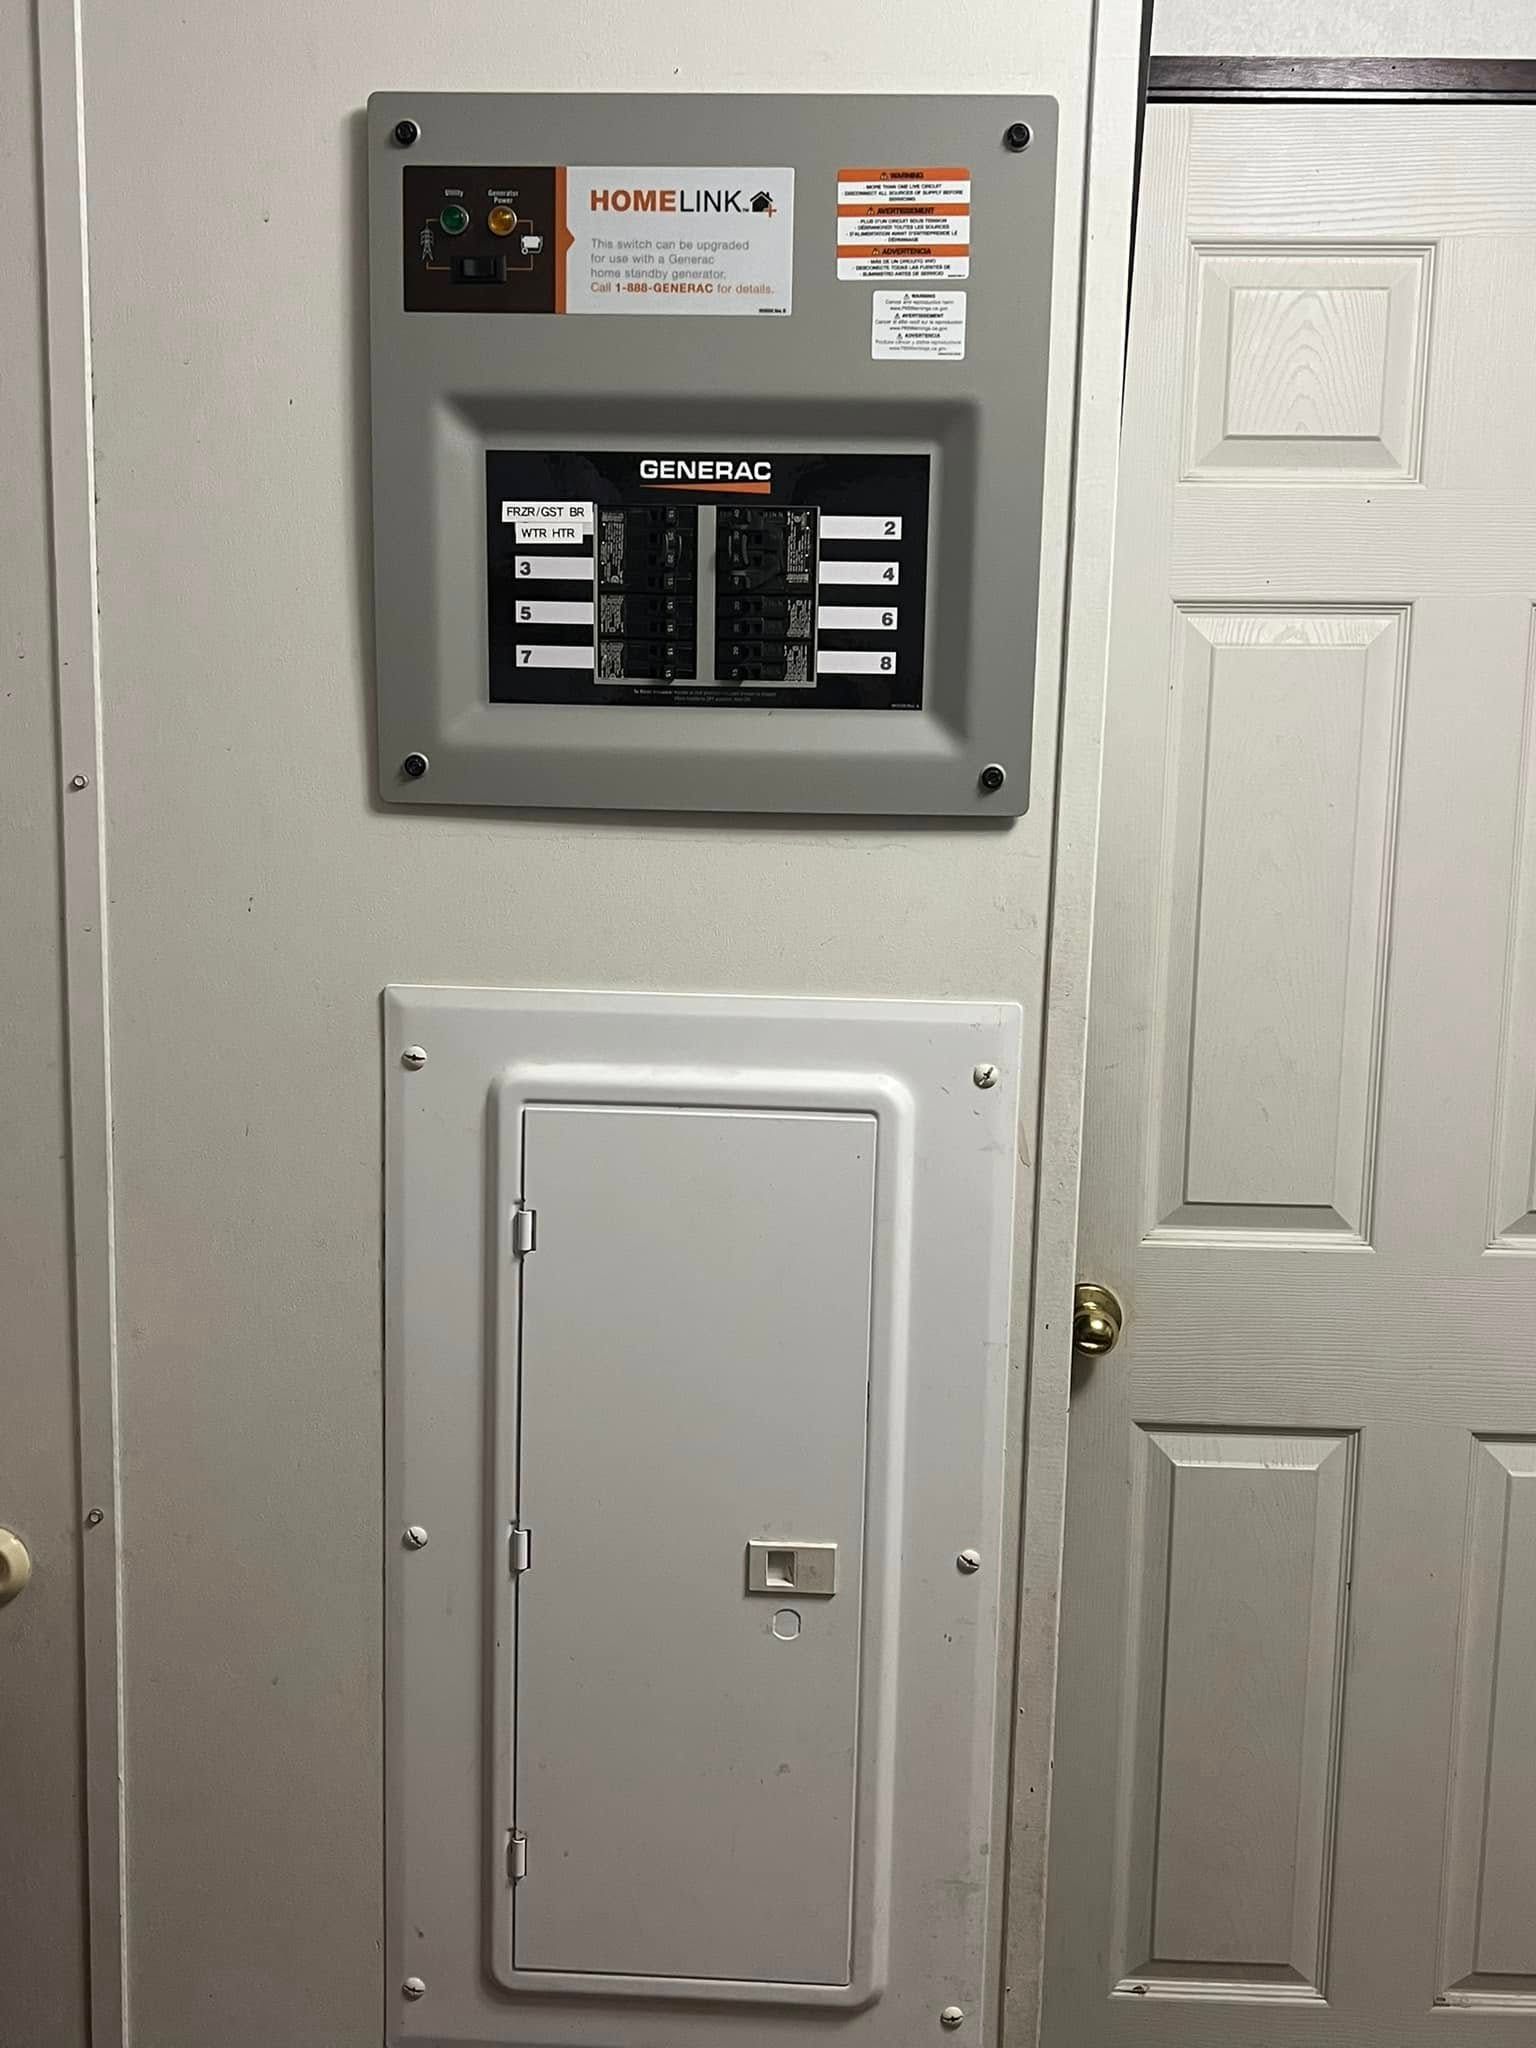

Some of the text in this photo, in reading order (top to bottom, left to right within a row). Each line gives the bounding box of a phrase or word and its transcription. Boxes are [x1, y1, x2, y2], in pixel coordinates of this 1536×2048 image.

[444, 189, 464, 198] Utility
[487, 189, 519, 197] Generator
[591, 238, 750, 253] This switch can be upgraded
[882, 247, 932, 255] ADVERTENCIA
[590, 254, 715, 265] for use with a Generac
[590, 268, 727, 281] home standby generator.
[590, 282, 775, 295] Call 1-888-GENERAC for details.
[639, 460, 772, 480] GENERAC
[506, 506, 585, 518] FRZR/GST BR
[521, 528, 575, 539] WTR HTR
[884, 521, 896, 535] 2
[519, 562, 531, 575] 3
[883, 567, 895, 581] 4
[520, 607, 532, 620] 5
[881, 612, 894, 626] 6
[520, 650, 532, 663] 7
[880, 656, 892, 670] 8
